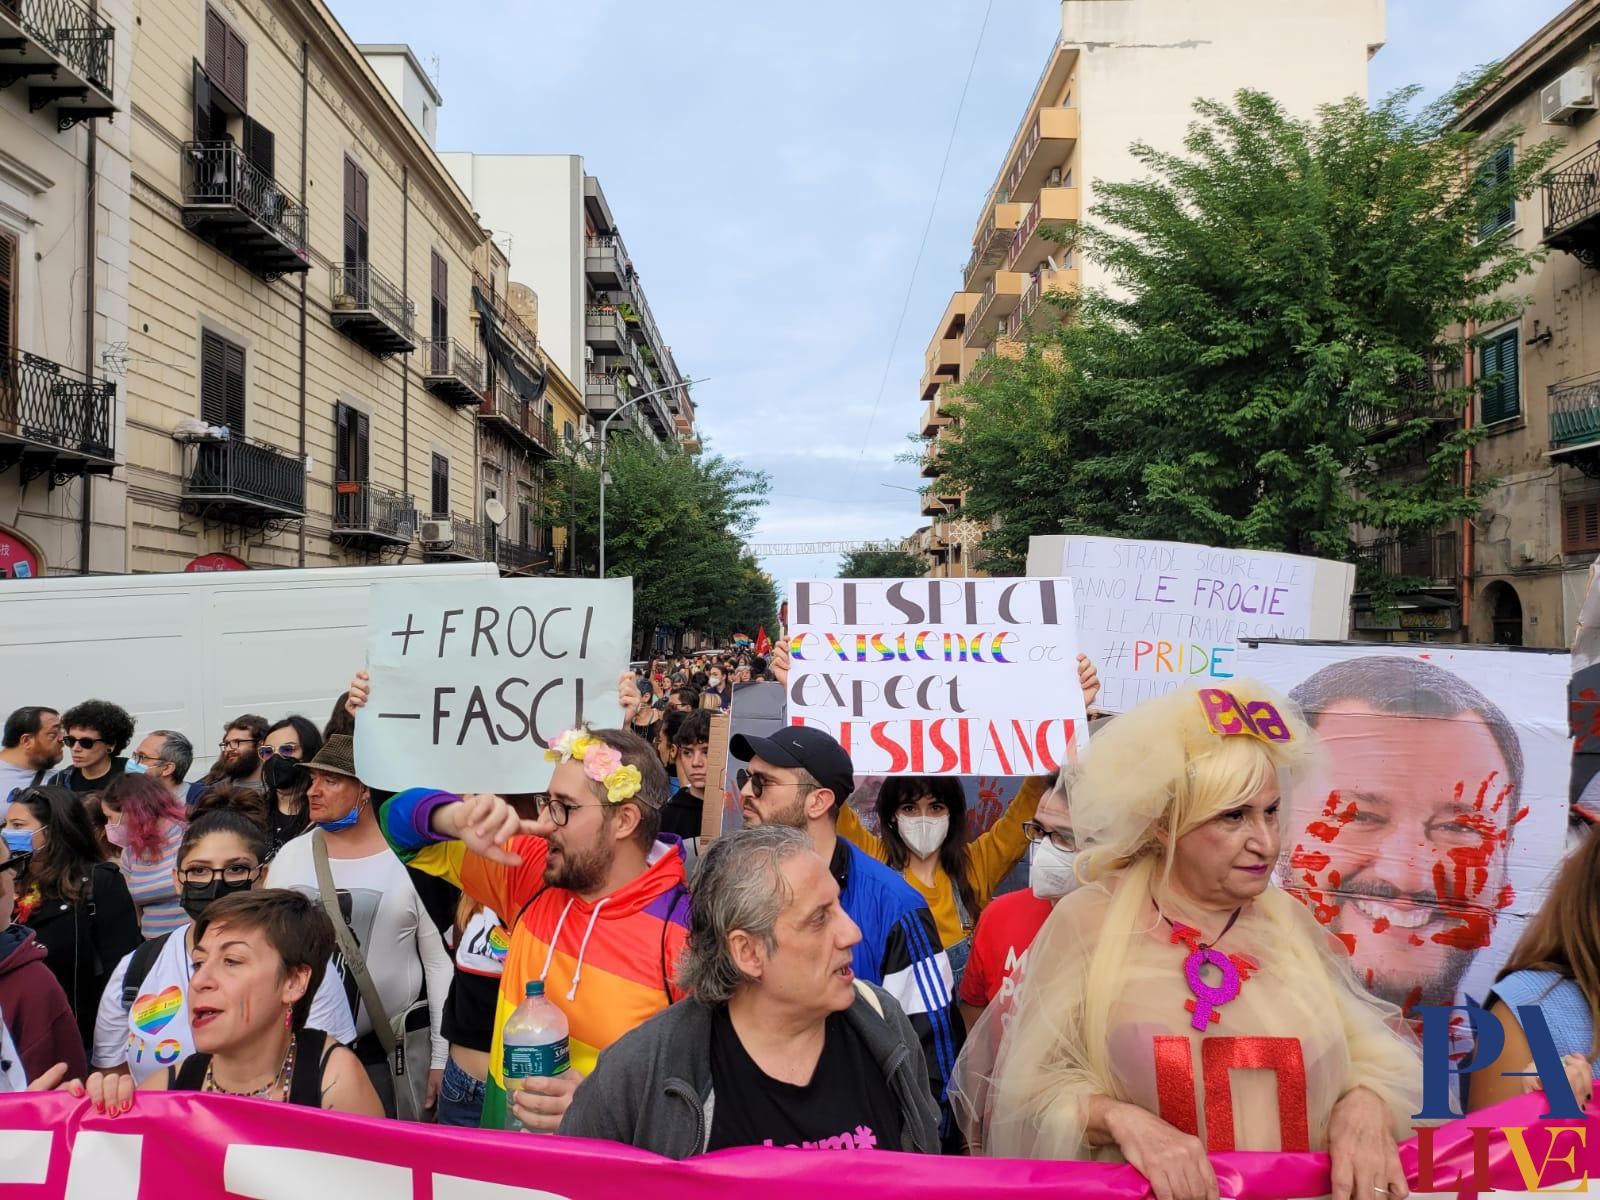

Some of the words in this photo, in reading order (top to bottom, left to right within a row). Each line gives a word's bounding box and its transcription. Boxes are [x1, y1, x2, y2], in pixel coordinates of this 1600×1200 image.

[1066, 541, 1097, 568] LE
[1112, 544, 1182, 571] STRADE
[1195, 551, 1262, 579] SICURE
[1275, 561, 1302, 586] LE
[793, 579, 1071, 626] RESPECT
[1135, 574, 1179, 603] LE
[1194, 578, 1289, 616] FROCIE
[438, 606, 594, 659] FROCI
[1101, 640, 1235, 679] #PRIDE
[432, 677, 584, 749] FASCI
